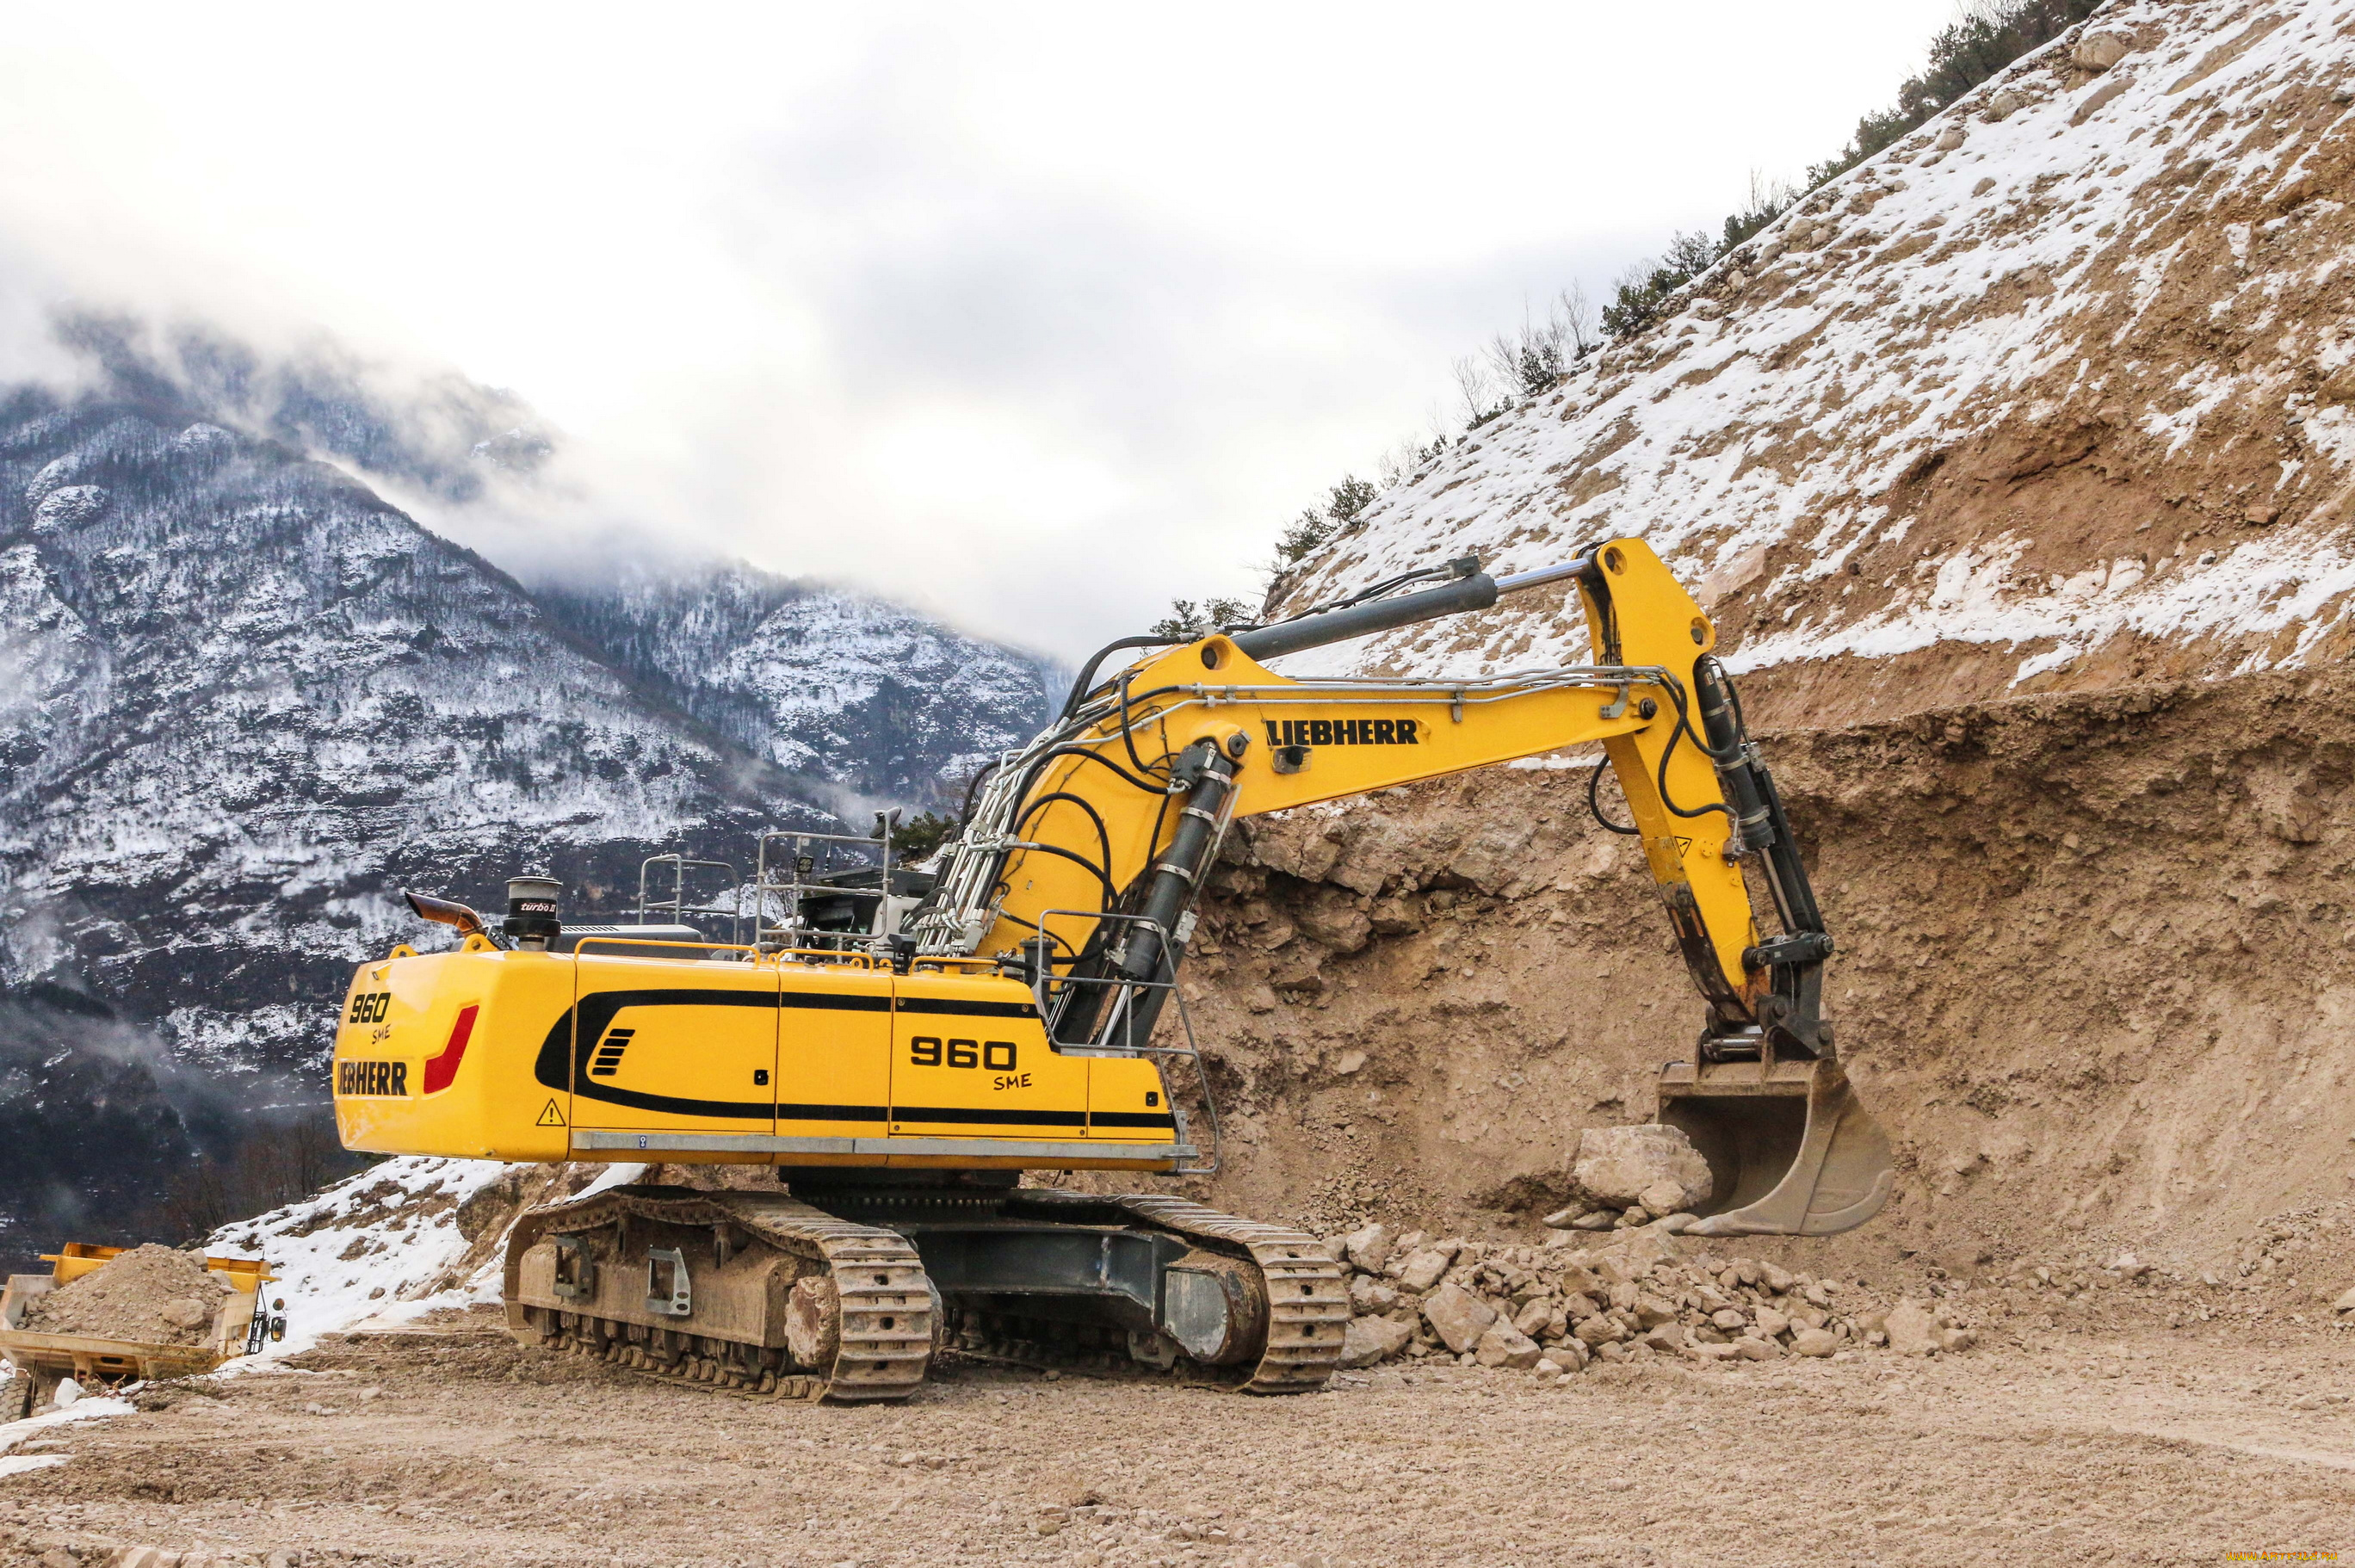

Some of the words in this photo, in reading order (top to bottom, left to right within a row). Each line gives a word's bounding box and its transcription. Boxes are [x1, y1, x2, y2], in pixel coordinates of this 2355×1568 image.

[1266, 719, 1419, 746] LIEBHERR
[521, 903, 549, 911] turbo
[349, 992, 391, 1023] 960
[372, 1024, 391, 1045] SME
[911, 1035, 1017, 1071] 960
[993, 1073, 1032, 1090] SME
